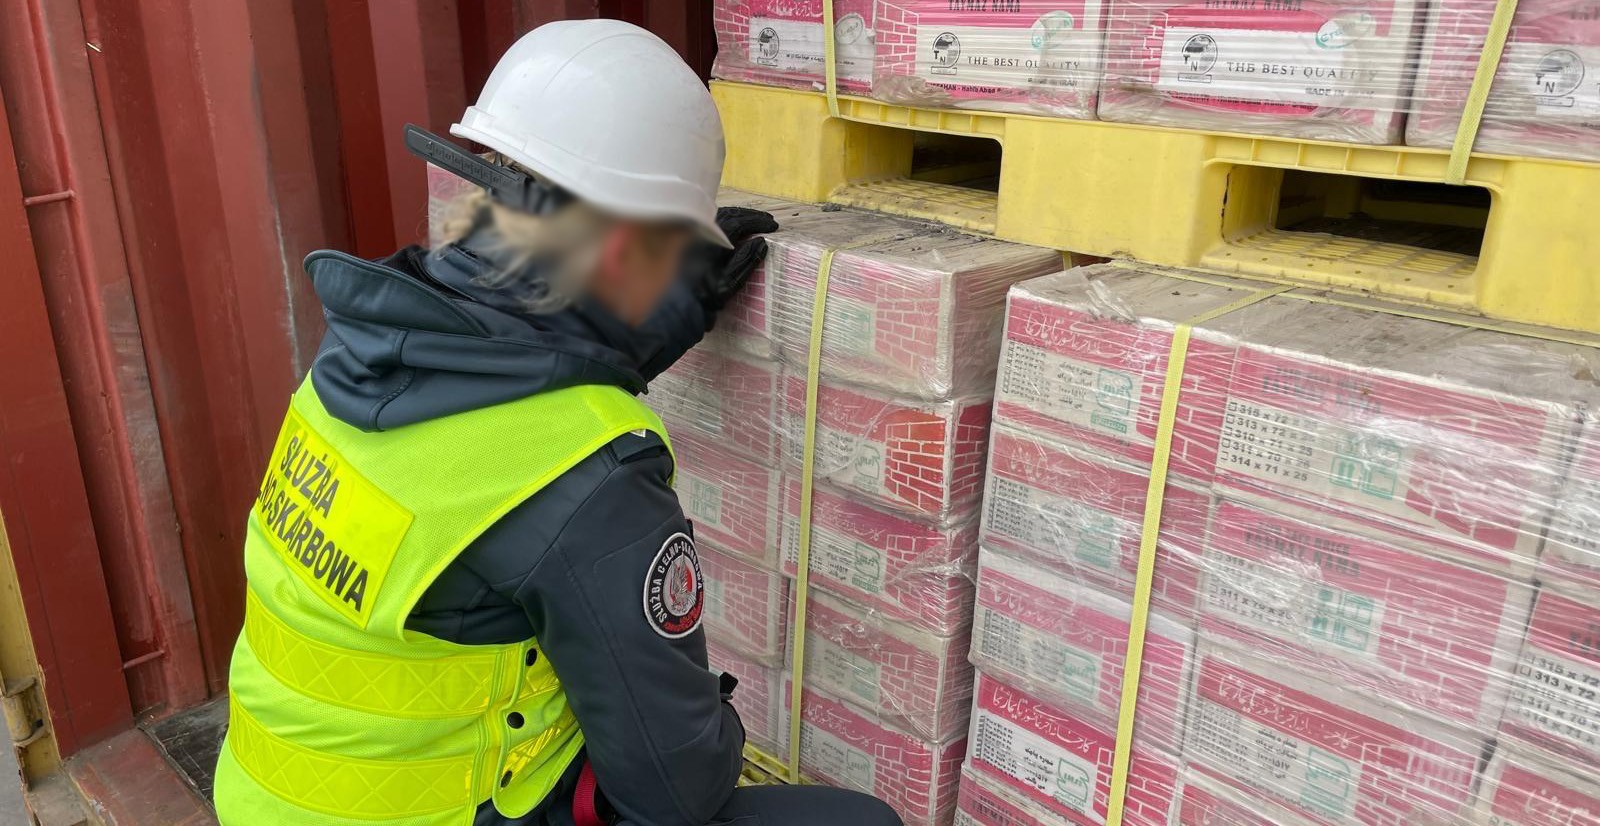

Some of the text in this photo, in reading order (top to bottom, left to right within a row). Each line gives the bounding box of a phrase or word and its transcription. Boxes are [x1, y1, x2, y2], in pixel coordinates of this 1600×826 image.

[968, 56, 988, 66] THE
[994, 58, 1020, 67] BEST
[1228, 62, 1255, 73] THE
[1263, 65, 1296, 76] BEST
[1236, 416, 1258, 429] 313
[1270, 426, 1286, 436] 72
[280, 436, 340, 519] SŁUŻBA
[1230, 455, 1251, 467] 314
[1264, 464, 1278, 474] 71
[1293, 470, 1308, 481] 25
[650, 578, 668, 623] SŁUŻBA
[1218, 588, 1239, 600] 311
[1533, 670, 1561, 687] 313
[1576, 686, 1596, 700] 72
[1526, 695, 1551, 711] 311
